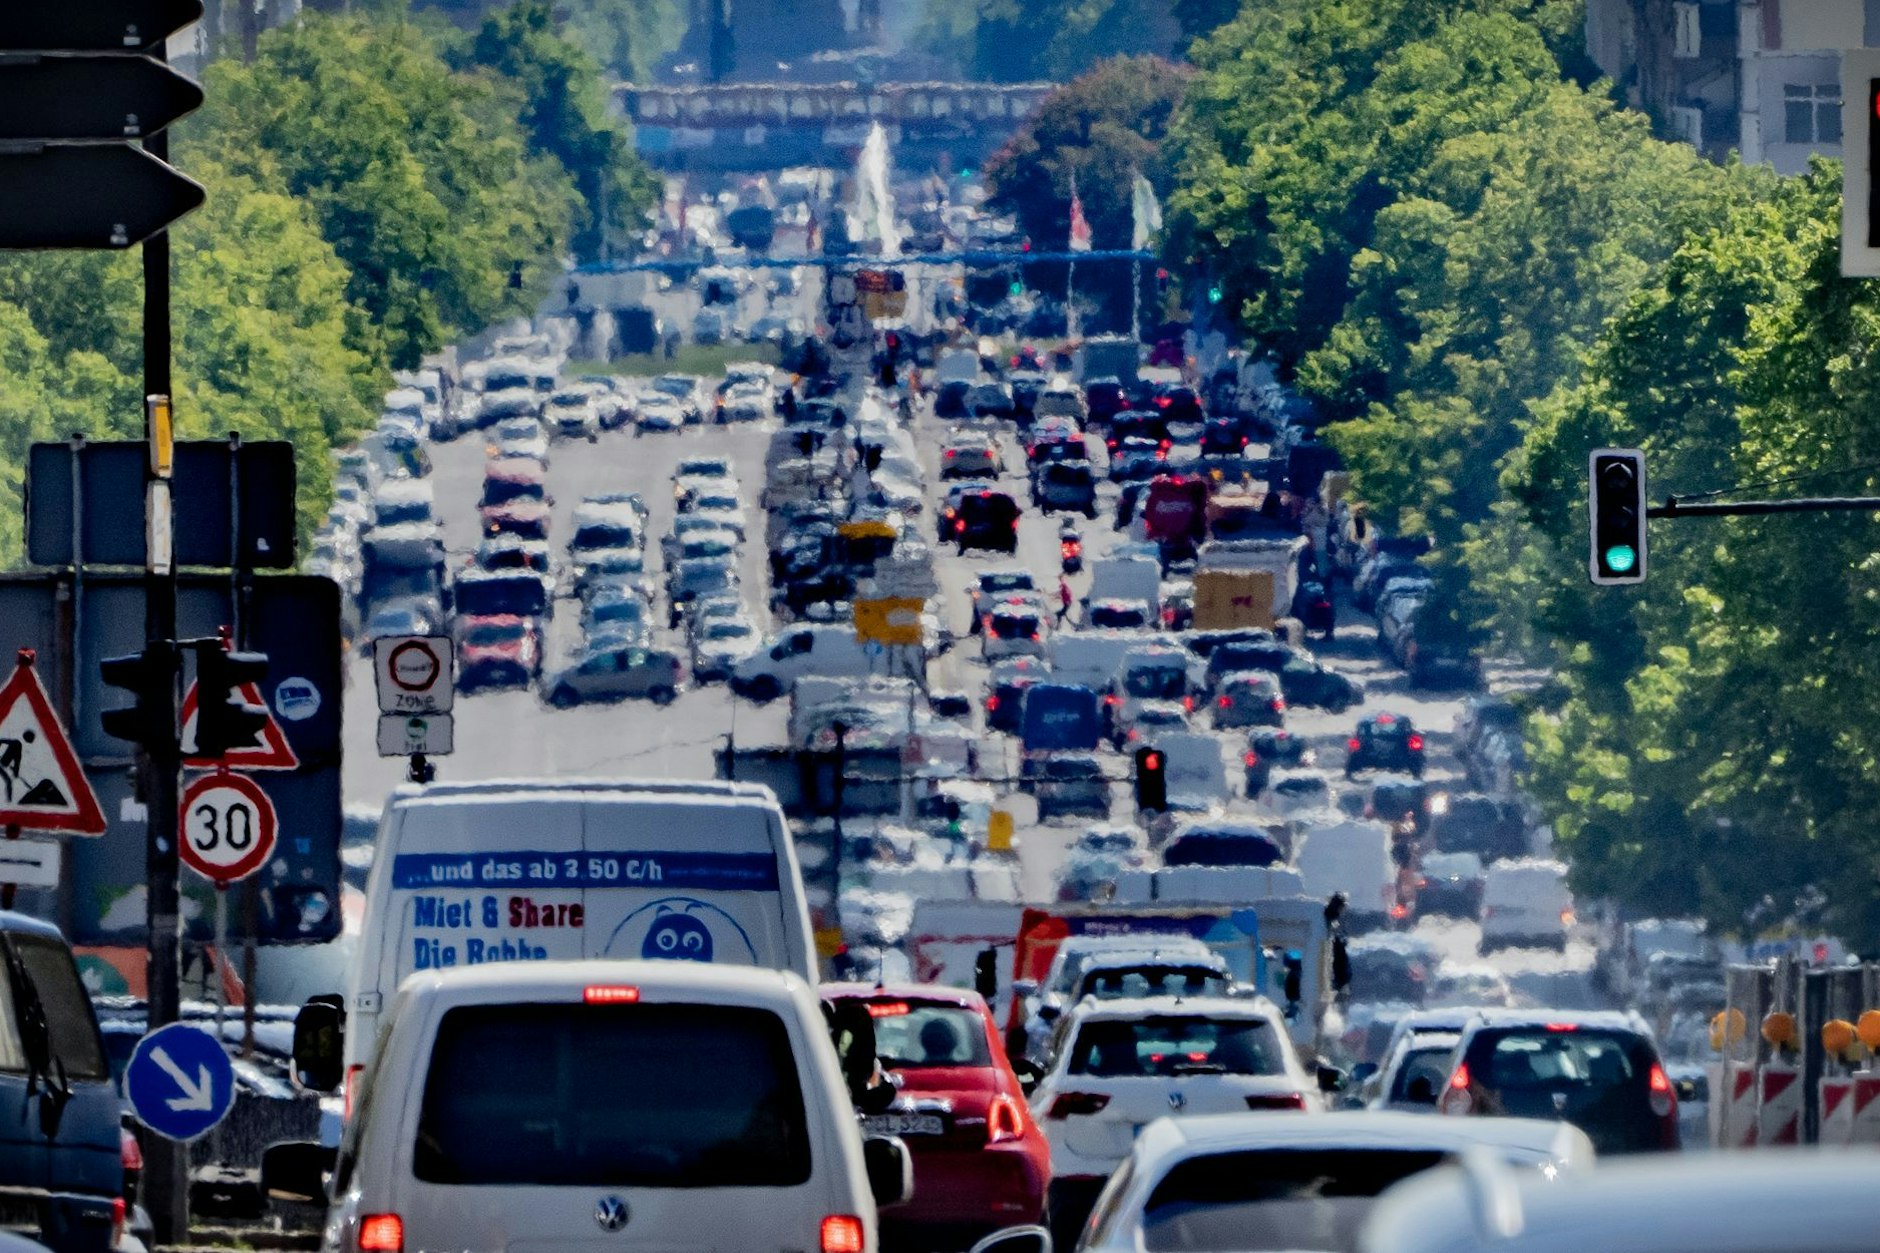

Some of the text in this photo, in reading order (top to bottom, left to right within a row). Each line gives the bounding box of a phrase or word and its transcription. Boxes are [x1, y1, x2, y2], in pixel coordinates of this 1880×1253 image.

[195, 802, 251, 851] 30
[482, 858, 522, 880] das
[529, 857, 557, 879] ab
[414, 896, 584, 928] Miet & Share
[414, 938, 547, 969] Die Robbe
